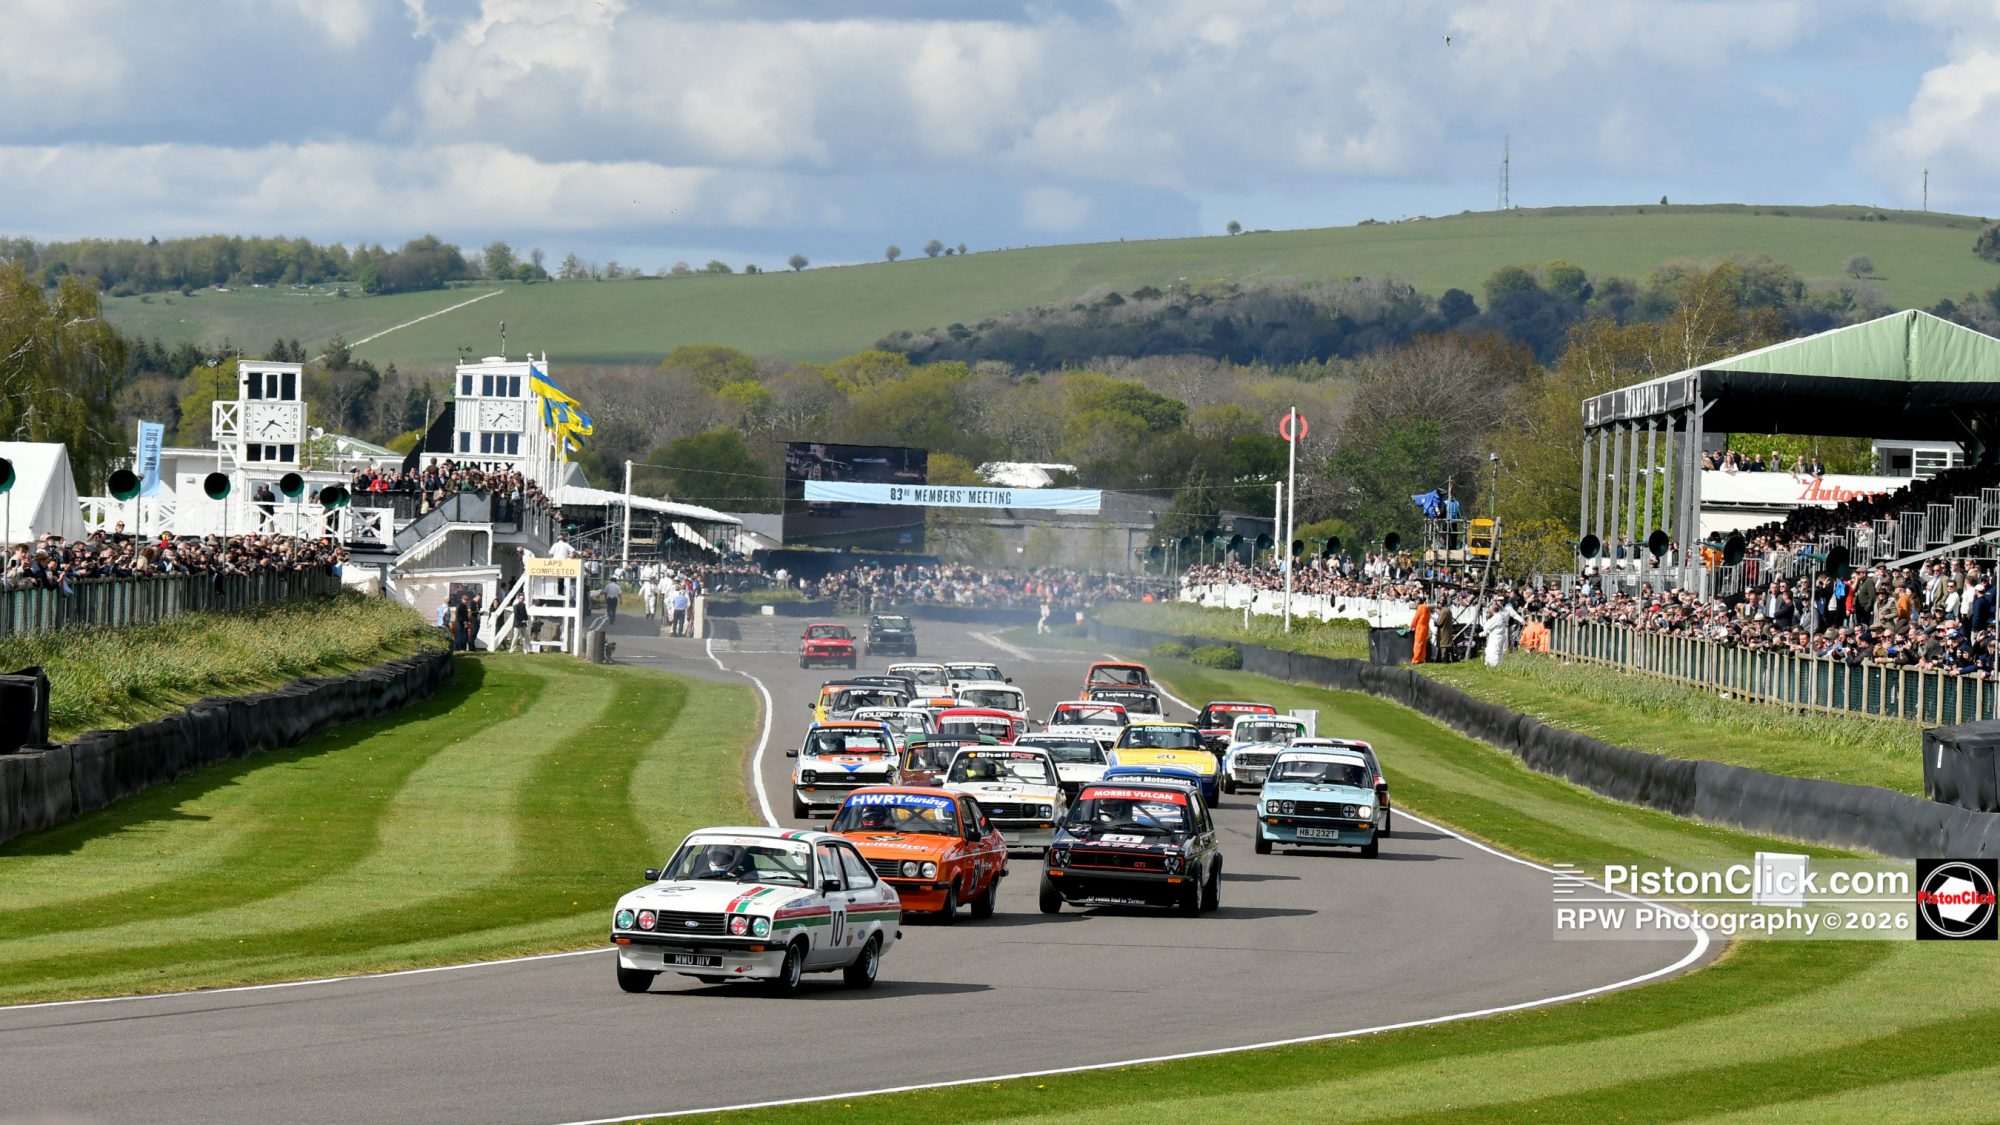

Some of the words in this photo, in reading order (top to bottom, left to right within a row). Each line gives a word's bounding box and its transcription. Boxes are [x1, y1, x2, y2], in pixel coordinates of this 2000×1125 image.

[451, 461, 515, 472] MINTEX
[968, 490, 1012, 504] MEETING
[543, 559, 563, 567] LAPS
[530, 567, 576, 576] COMPLETED
[1093, 787, 1132, 797] MORRIS
[1133, 788, 1174, 801] VULCAN
[851, 794, 905, 806] HWRT
[902, 795, 950, 808] tuning
[1300, 827, 1314, 837] HBJ
[1315, 827, 1336, 838] 232T
[831, 910, 844, 947] 10
[674, 954, 694, 965] MWU
